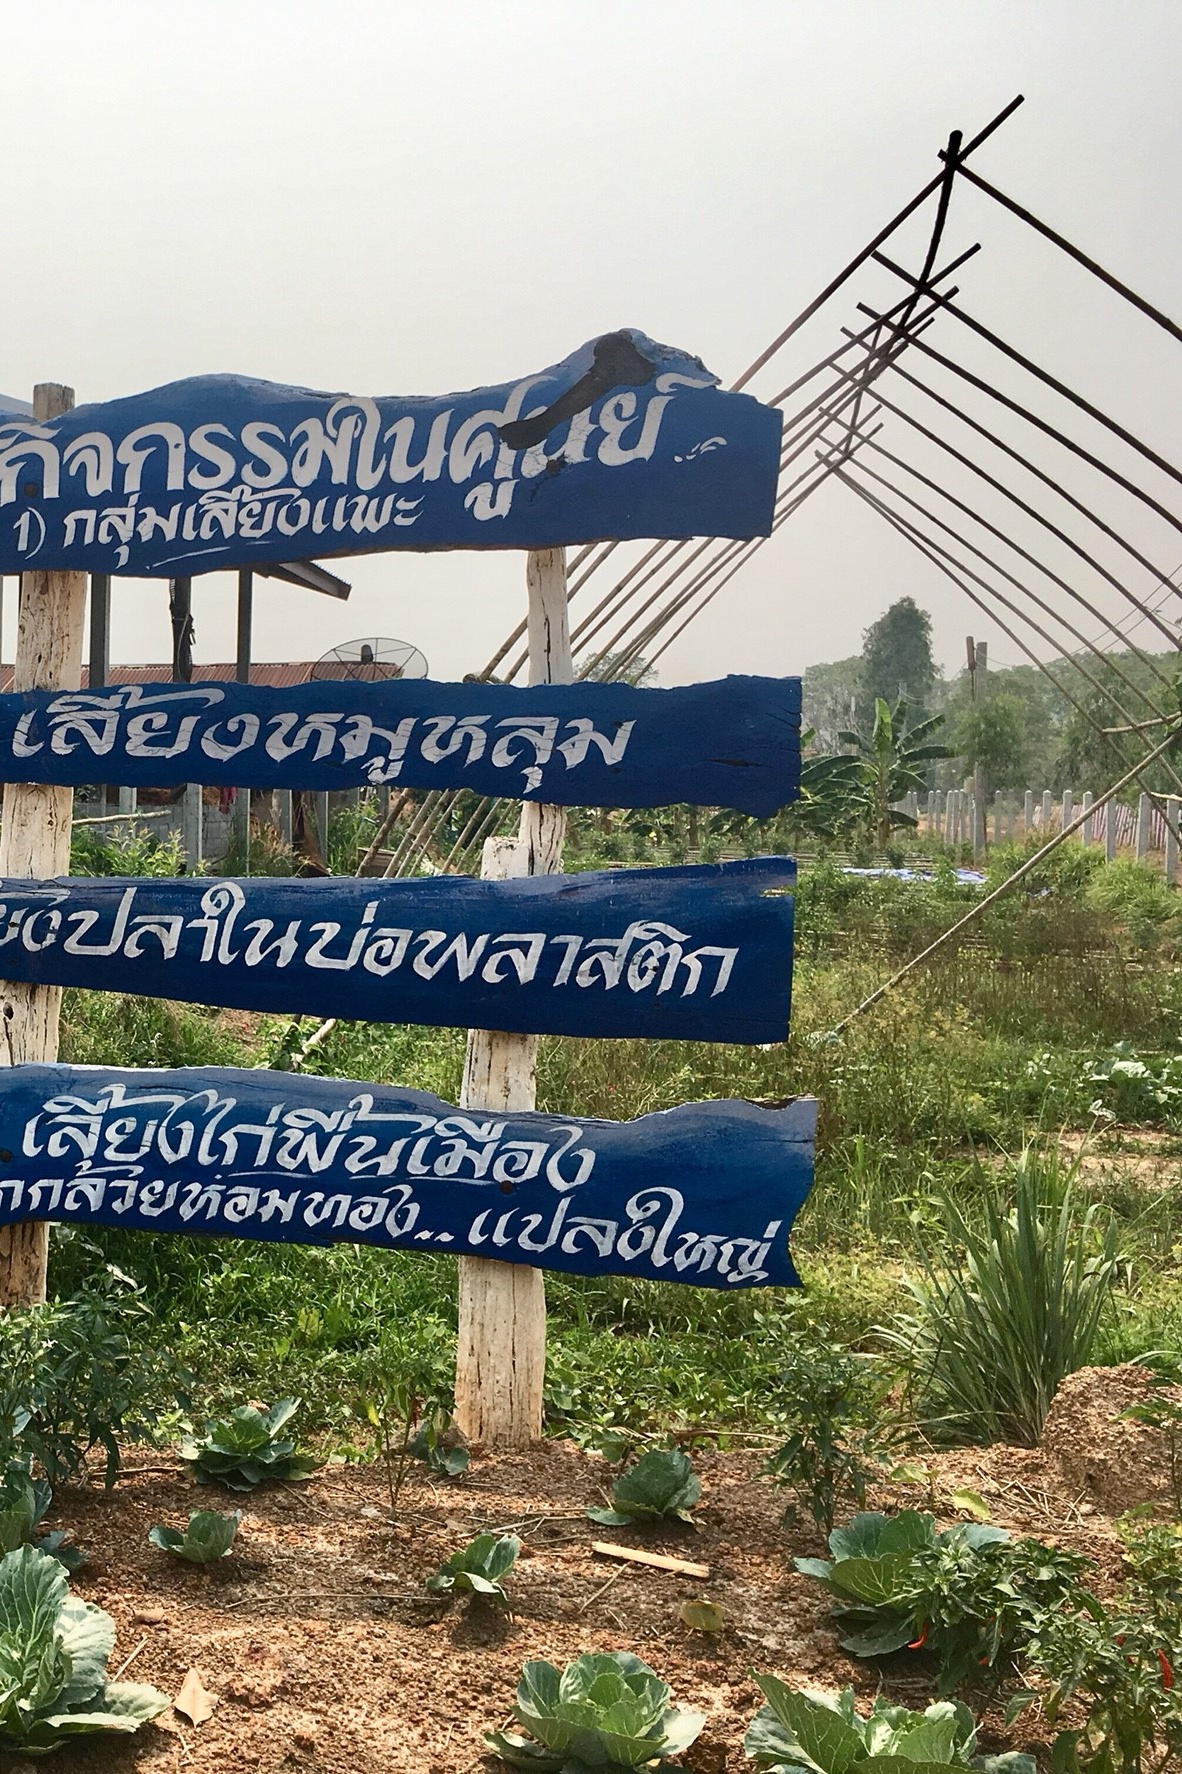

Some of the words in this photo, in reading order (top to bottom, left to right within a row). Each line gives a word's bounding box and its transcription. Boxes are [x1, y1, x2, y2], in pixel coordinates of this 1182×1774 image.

[12, 506, 47, 560] 1)
[11, 685, 637, 795] เลี้ยงหมูหลุม
